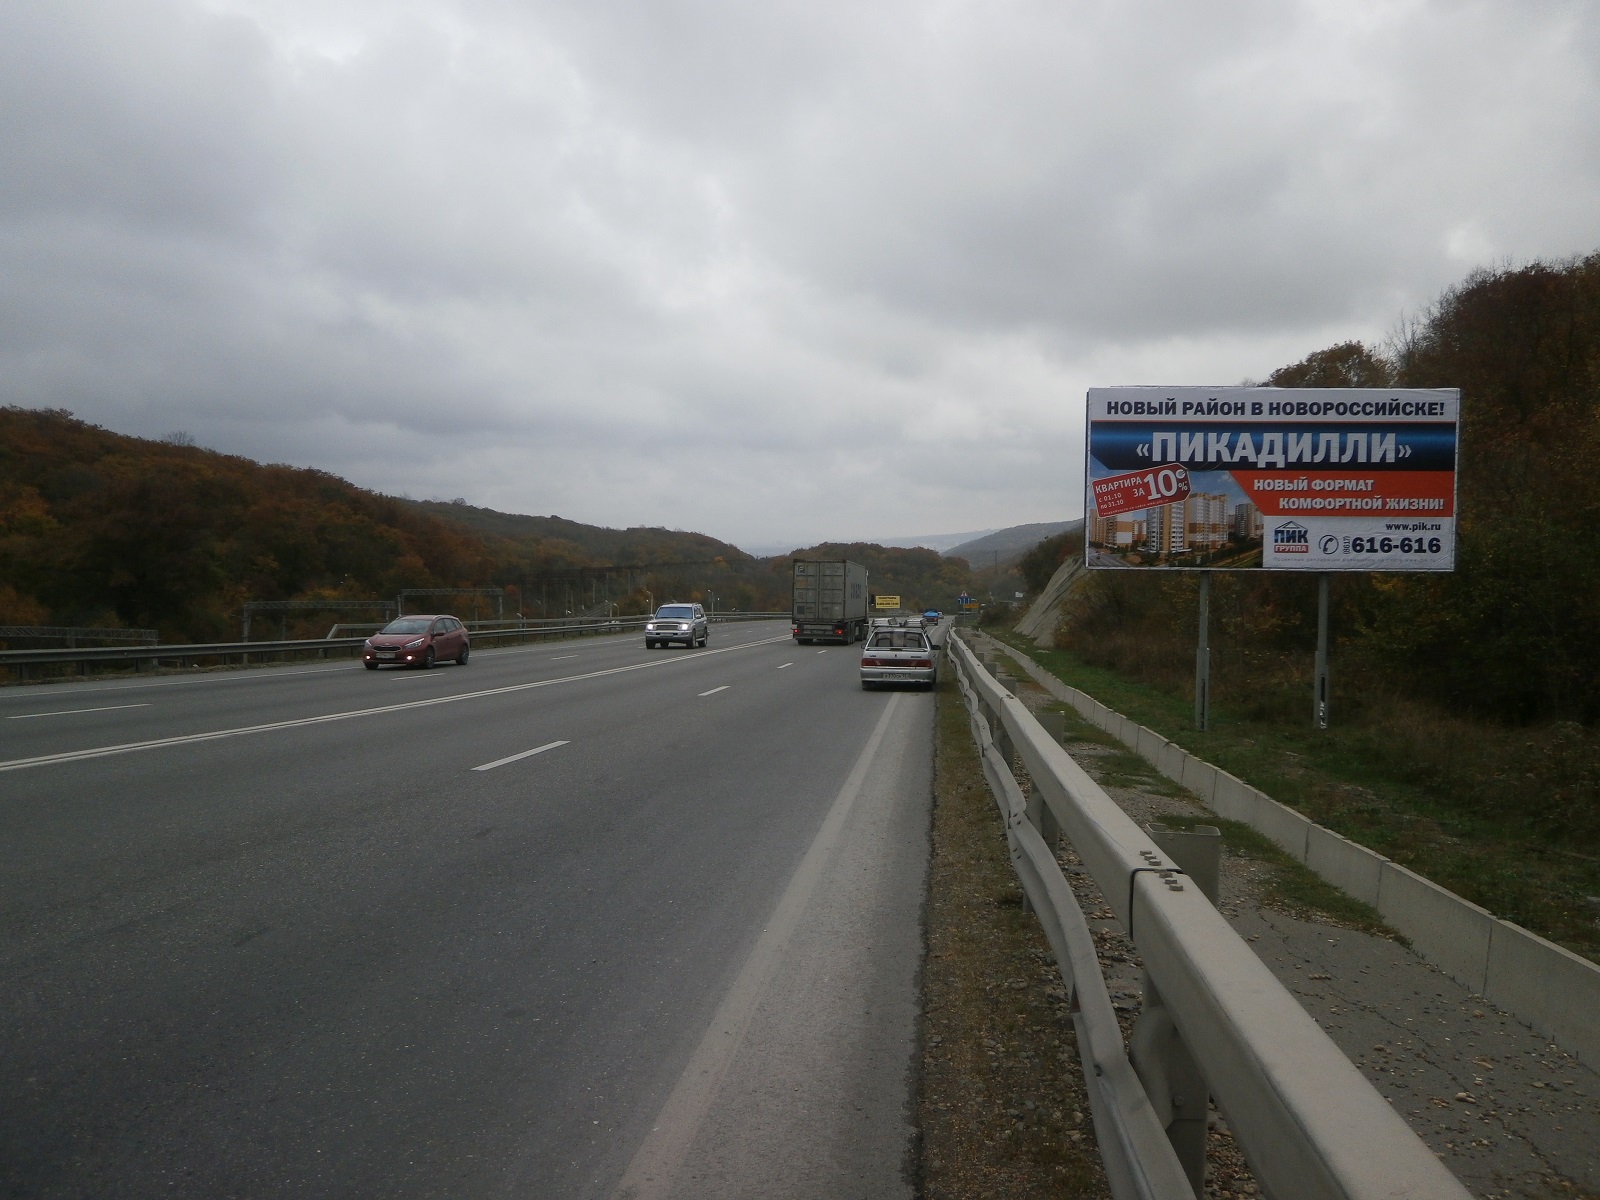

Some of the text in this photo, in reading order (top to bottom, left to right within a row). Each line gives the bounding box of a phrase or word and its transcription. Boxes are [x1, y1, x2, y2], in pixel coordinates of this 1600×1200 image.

[1106, 397, 1445, 416] НОВЫЙ РАЙОН В НОВОРОССИЙСКЕ!
[1136, 431, 1412, 468] «ПИКАДИЛЛИ»
[1095, 476, 1143, 494] КВАРТИРА
[1253, 476, 1374, 491] НОВЫЙ ФОРМАТ
[1103, 492, 1122, 502] 01.10
[1132, 487, 1145, 498] ЗА
[1108, 499, 1124, 508] 31.10
[1279, 495, 1444, 510] КОМФОРТНОЙ ЖИЗНИ!
[1385, 522, 1441, 533] www.pik.ru
[1274, 529, 1309, 544] ПИК
[1275, 544, 1308, 553] ГРУППА
[1351, 537, 1441, 554] 616-616
